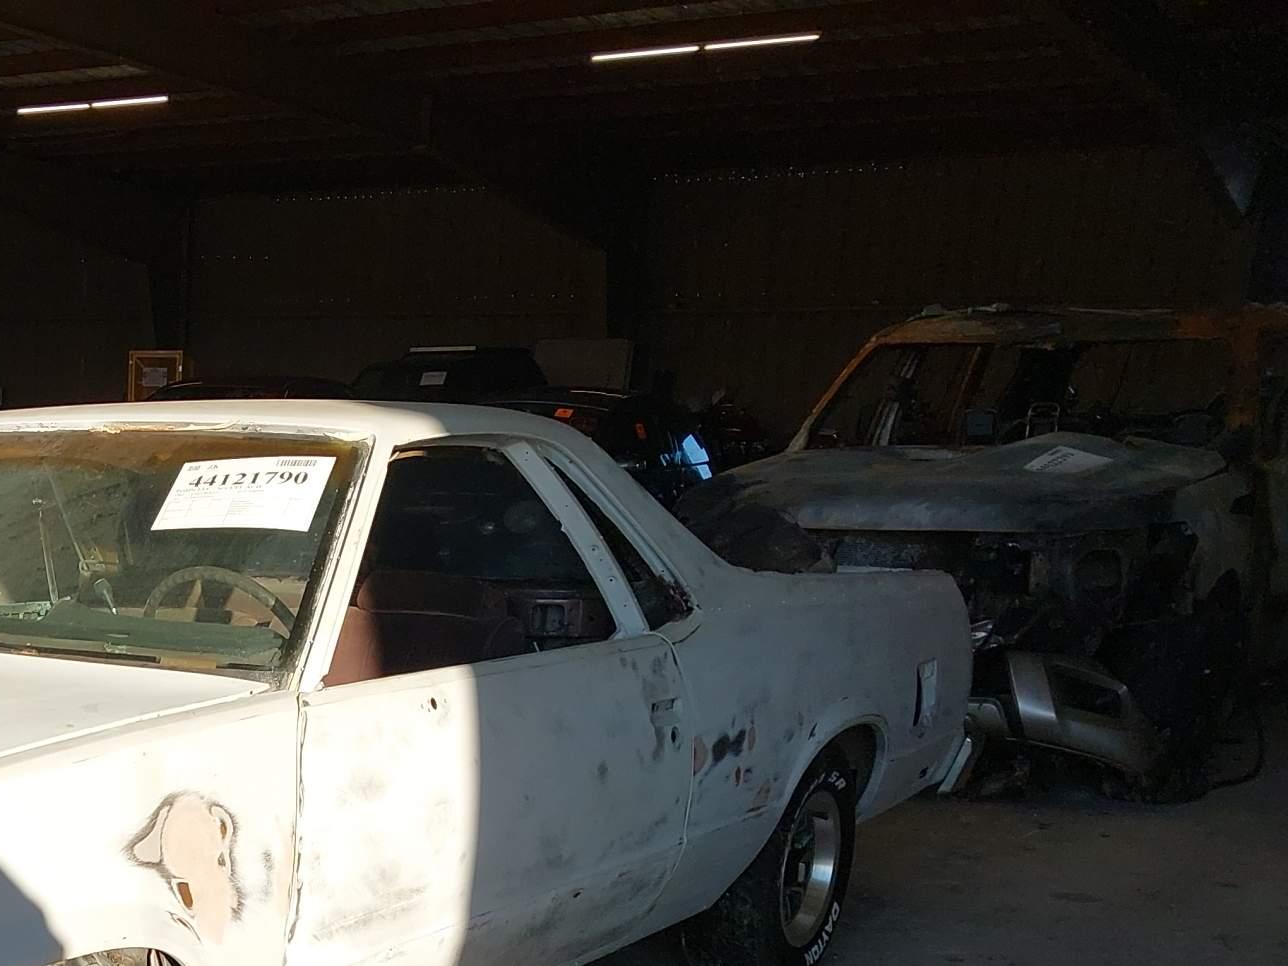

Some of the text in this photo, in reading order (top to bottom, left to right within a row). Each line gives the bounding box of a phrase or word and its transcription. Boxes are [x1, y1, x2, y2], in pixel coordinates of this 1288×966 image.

[188, 471, 309, 488] 44121790
[828, 770, 847, 790] SR
[803, 901, 840, 966] DAYTON
